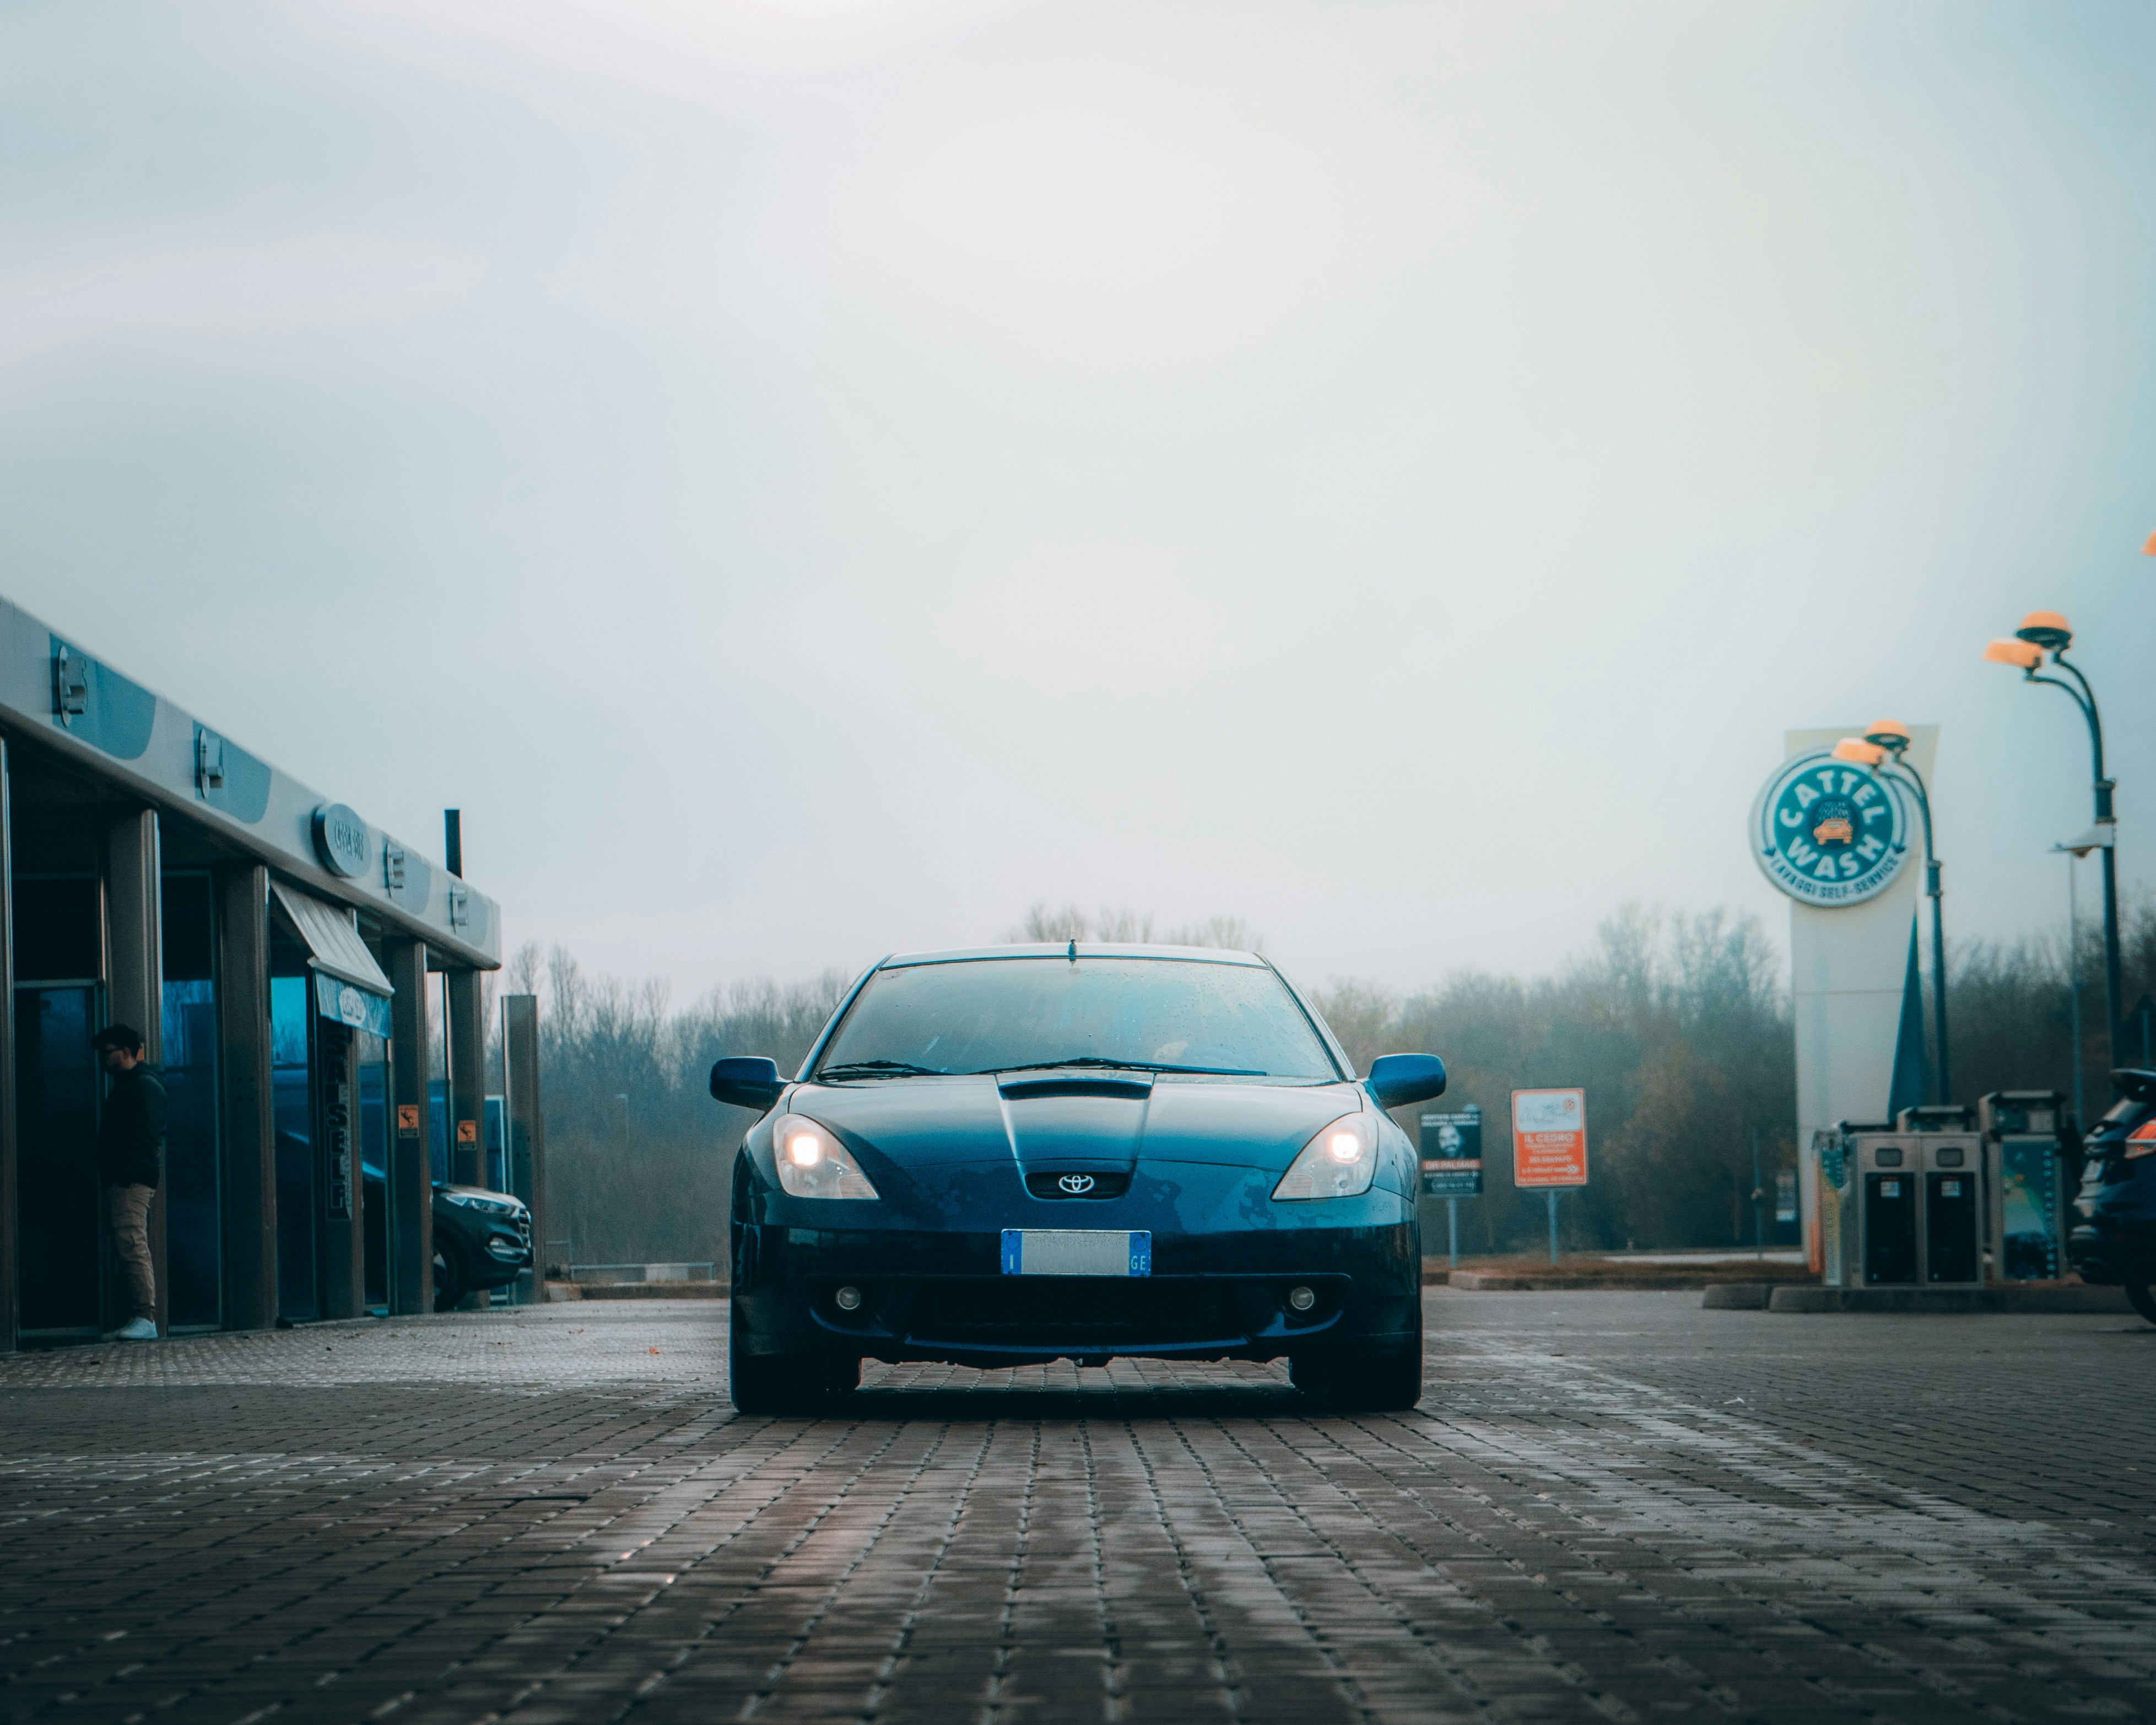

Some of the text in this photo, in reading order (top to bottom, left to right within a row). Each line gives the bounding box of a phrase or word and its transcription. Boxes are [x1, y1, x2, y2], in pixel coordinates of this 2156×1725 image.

[1780, 770, 1885, 827] CATTEL
[1770, 858, 1817, 896] LAVAGGI
[1787, 834, 1885, 880] WASH
[327, 1102, 348, 1208] SELF
[1536, 1133, 1576, 1143] CEDRO
[1131, 1255, 1145, 1270] GE
